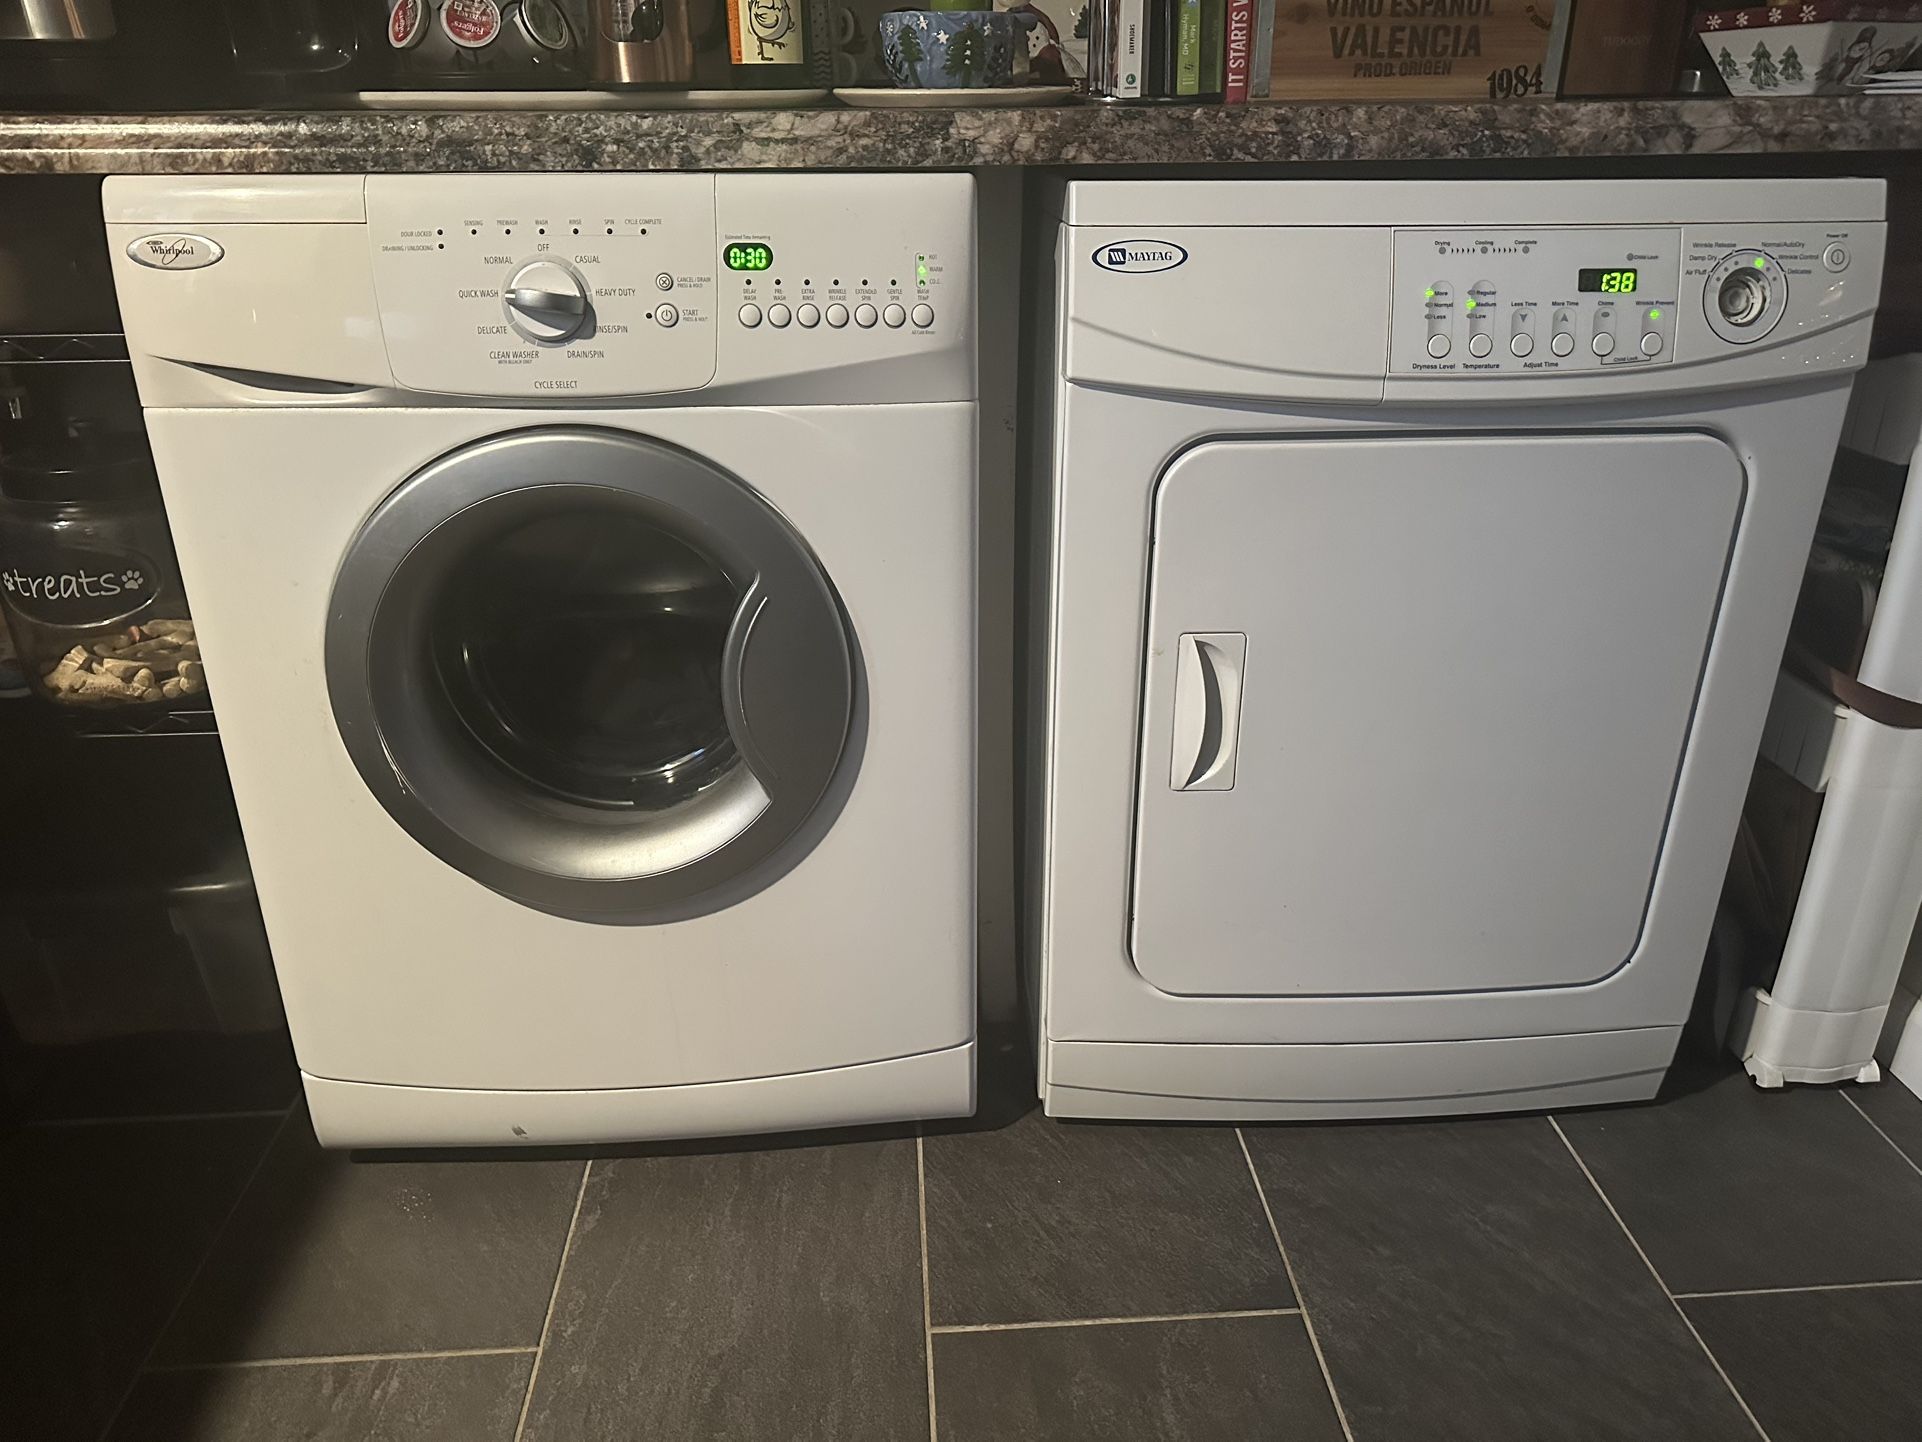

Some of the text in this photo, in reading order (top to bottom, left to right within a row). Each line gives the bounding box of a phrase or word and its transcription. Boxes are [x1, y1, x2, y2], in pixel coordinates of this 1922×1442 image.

[453, 20, 485, 35] Folgers
[1229, 11, 1248, 68] STARTS
[1329, 24, 1482, 59] VALENCIA
[1353, 59, 1453, 78] PROD. ORIGEN
[1228, 73, 1243, 87] IT
[1486, 64, 1544, 99] 1984
[150, 245, 194, 257] Whirlpool
[537, 243, 550, 252] OFF
[484, 256, 513, 264] NORMAL
[574, 255, 601, 264] CASUAL
[729, 247, 767, 268] 0:30
[1127, 251, 1173, 262] MAYTAG
[1601, 272, 1635, 292] 1:38
[458, 289, 499, 298] QUICK WASH
[595, 288, 636, 297] HEAVY DUTY
[477, 326, 508, 335] DELICATE
[489, 350, 540, 360] CLEAN WASHER
[567, 350, 604, 359] DRAIN/SPIN
[1462, 362, 1500, 370] Temperature
[1523, 361, 1543, 369] Adjust
[534, 380, 578, 389] CYCLE SELECT
[14, 568, 121, 600] treats
